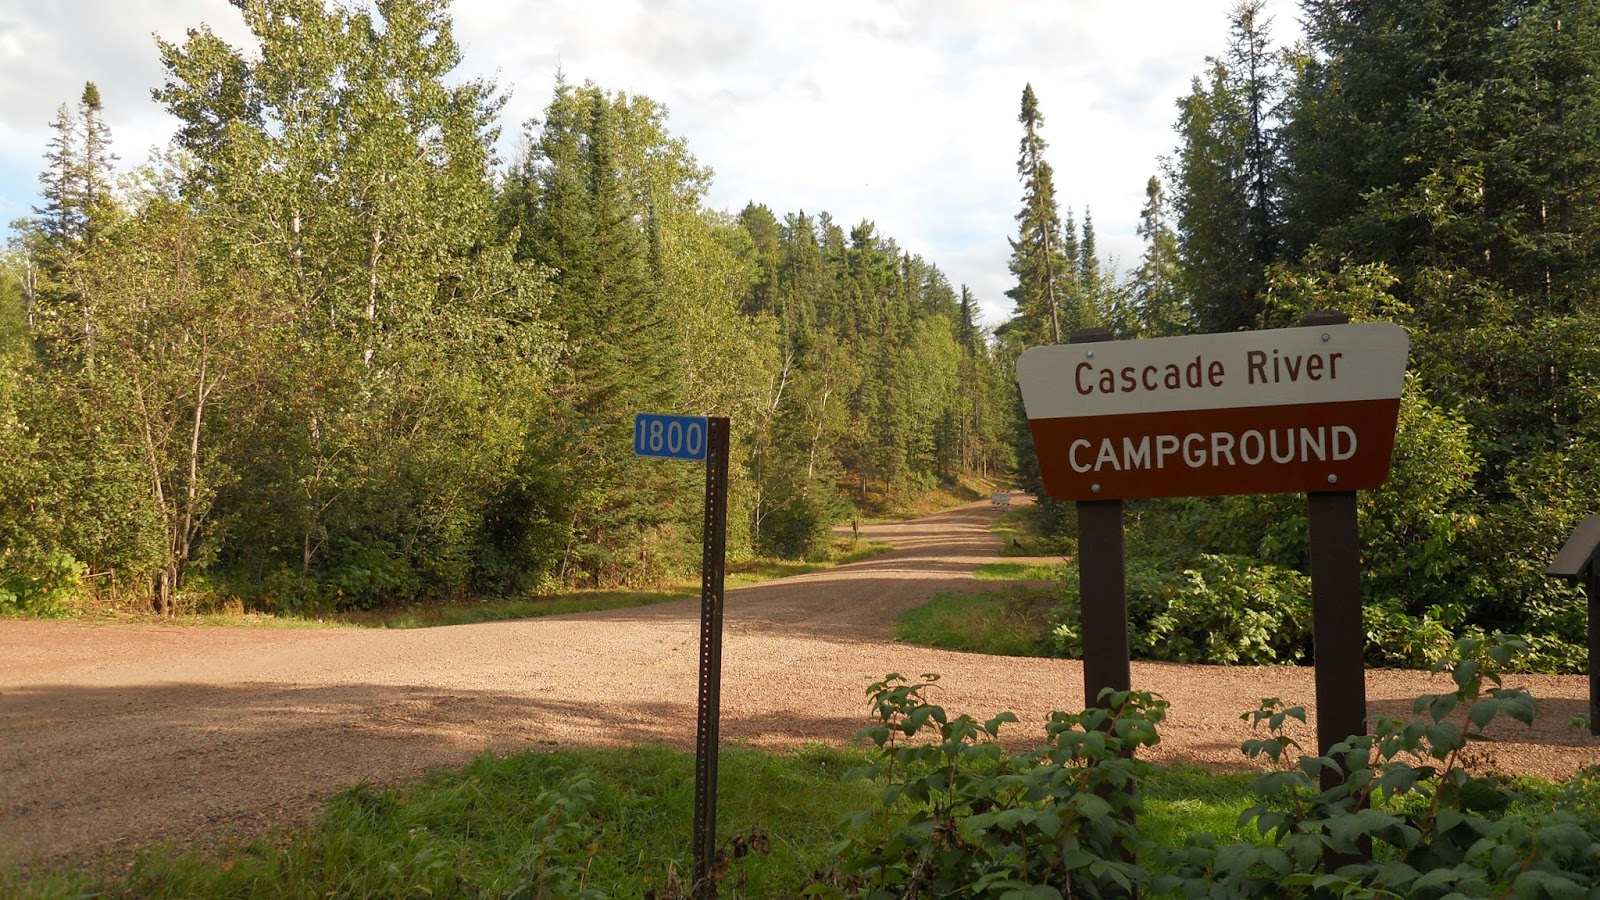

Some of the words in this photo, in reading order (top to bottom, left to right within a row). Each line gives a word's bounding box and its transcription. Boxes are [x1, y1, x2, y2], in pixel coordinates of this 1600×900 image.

[1074, 354, 1225, 395] Cascade
[1247, 348, 1343, 385] River
[640, 419, 702, 455] 1800
[1068, 425, 1358, 474] CAMPGROUND
